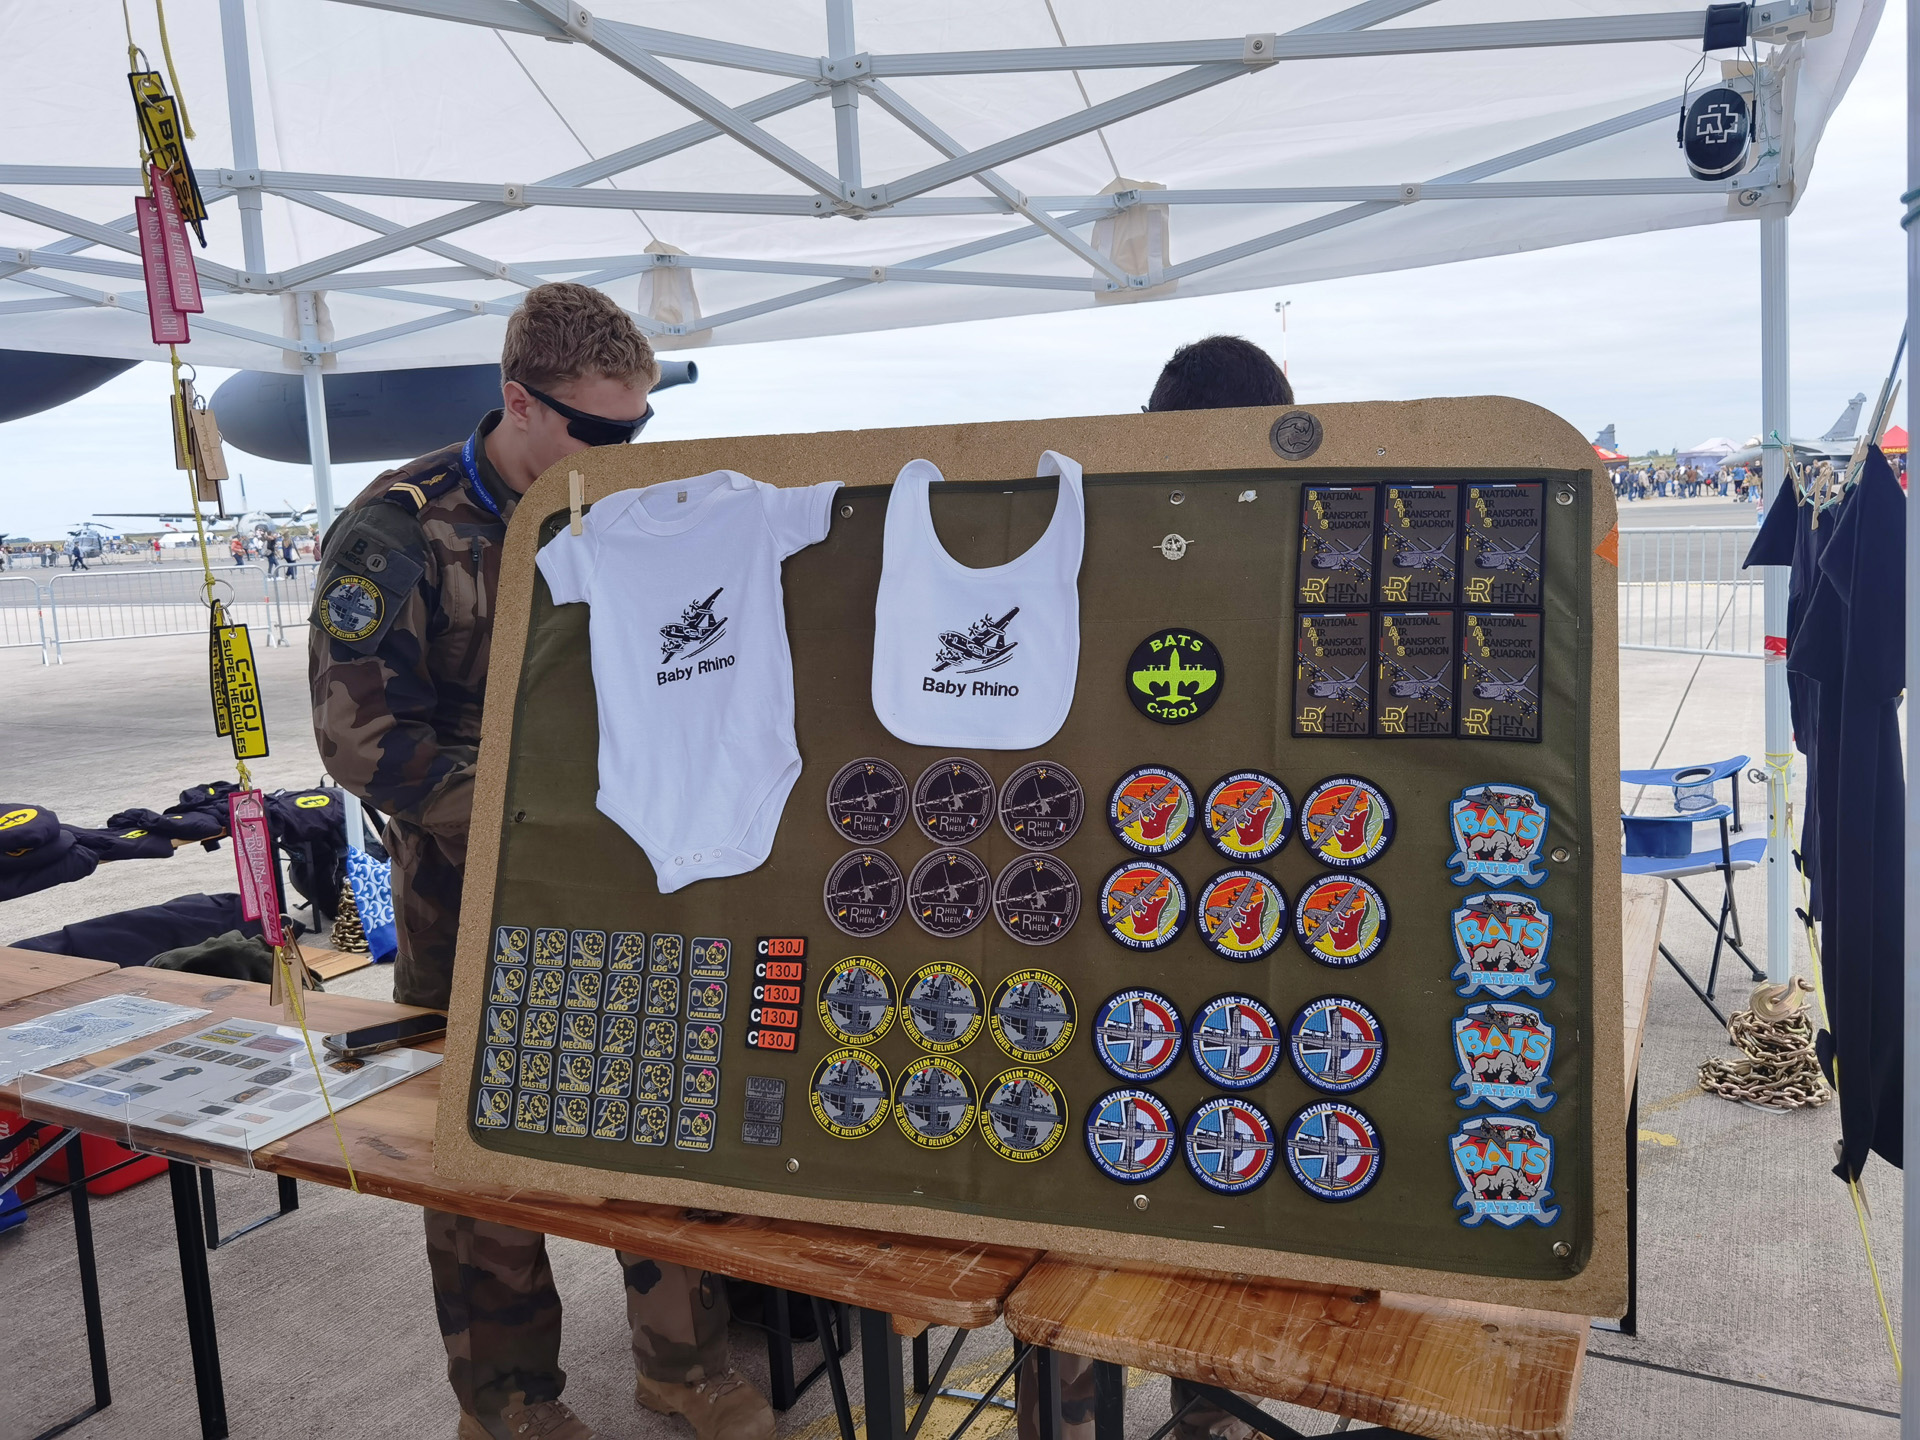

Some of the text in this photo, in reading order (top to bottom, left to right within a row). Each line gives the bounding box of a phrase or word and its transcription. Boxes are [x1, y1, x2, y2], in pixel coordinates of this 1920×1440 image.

[160, 186, 194, 306] KISS ME BEFORE FLIGHT
[1309, 490, 1362, 500] BINATIONAL
[1390, 488, 1446, 498] BINATIONAL
[1471, 488, 1528, 498] BINATIONAL
[1312, 500, 1331, 510] AIR
[1394, 498, 1412, 508] AIR
[1475, 498, 1494, 508] AIR
[1316, 510, 1368, 519] TRANSPORT
[1398, 508, 1451, 518] TRANSPORT
[1479, 508, 1535, 518] TRANSPORT
[1320, 520, 1370, 530] SQUADRON
[1402, 518, 1454, 528] SQUADRON
[1483, 518, 1538, 528] SQUADRON
[1303, 618, 1358, 627] BINATIONAL
[1384, 616, 1440, 626] BINATIONAL
[1468, 616, 1526, 626] BINATIONAL
[1308, 627, 1326, 637] AIR
[1389, 626, 1407, 636] AIR
[1472, 626, 1492, 636] AIR
[1149, 634, 1204, 652] BATS
[1311, 636, 1363, 646] TRANSPORT
[1392, 636, 1446, 646] TRANSPORT
[1476, 636, 1532, 648] TRANSPORT
[1316, 646, 1366, 656] SQUADRON
[1396, 646, 1449, 656] SQUADRON
[1481, 646, 1535, 658] SQUADRON
[657, 655, 735, 686] Baby Rhino
[922, 676, 1019, 697] Baby Rhino
[214, 664, 226, 730] HERCULES
[223, 640, 246, 754] SUPER HERCULES
[235, 659, 260, 732] C-130J
[1146, 702, 1198, 718] C-130J
[1454, 806, 1545, 840] BATS
[1120, 832, 1146, 852] PROTECT
[1164, 832, 1186, 852] RHINOS
[1216, 834, 1286, 859] PROTECT THE RHINOS
[1318, 836, 1387, 866] PROTECT THE RHINOS
[1467, 861, 1528, 876] PATROL
[1112, 928, 1140, 948] PROTECT
[1156, 925, 1178, 944] RHINOS
[1456, 914, 1548, 950] BATS
[1216, 928, 1283, 958] PROTECT THE RHINOS
[1311, 936, 1381, 964] PROTECT THE RHINOS
[497, 955, 520, 963] PILOT
[572, 959, 602, 967] MECANO
[834, 958, 886, 978] RHIN-RHEIN
[918, 964, 973, 986] RHIN-RHEIN
[1471, 971, 1534, 986] PATROL
[1006, 972, 1063, 992] RHIN-RHEIN
[492, 994, 513, 1002] PILOT
[567, 999, 596, 1008] MECANO
[838, 1034, 848, 1042] WE
[876, 1006, 894, 1036] TOGETHER
[922, 1039, 932, 1048] WE
[960, 1015, 982, 1044] TOGETHER
[562, 1041, 593, 1049] MECANO
[1012, 1048, 1022, 1058] WE
[1052, 1022, 1073, 1052] TOGETHER
[1458, 1025, 1550, 1063] BATS
[603, 1045, 624, 1053] AVIO
[686, 1054, 716, 1062] PAILLEUX
[826, 1050, 880, 1070] RHIN-RHEIN
[908, 1058, 963, 1076] RHIN-RHEIN
[484, 1076, 506, 1084] PILOT
[522, 1081, 548, 1089] MASTER
[999, 1070, 1056, 1092] RHIN-RHEIN
[559, 1083, 590, 1092] MECANO
[1472, 1082, 1536, 1098] PATROL
[640, 1092, 657, 1100] LOG
[684, 1096, 714, 1105] PAILLEUX
[830, 1126, 840, 1134] WE
[868, 1099, 888, 1128] TOGETHER
[478, 1118, 501, 1126] PILOT
[518, 1122, 545, 1132] MASTER
[917, 1136, 928, 1145] WE
[956, 1104, 975, 1136] TOGETHER
[556, 1125, 586, 1134] MECANO
[595, 1129, 616, 1137] AVIO
[678, 1140, 709, 1149] PAILLEUX
[1000, 1146, 1010, 1156] WE
[1040, 1124, 1064, 1152] TOGETHER
[1456, 1140, 1550, 1176] BATS
[1476, 1200, 1540, 1214] PATROL
